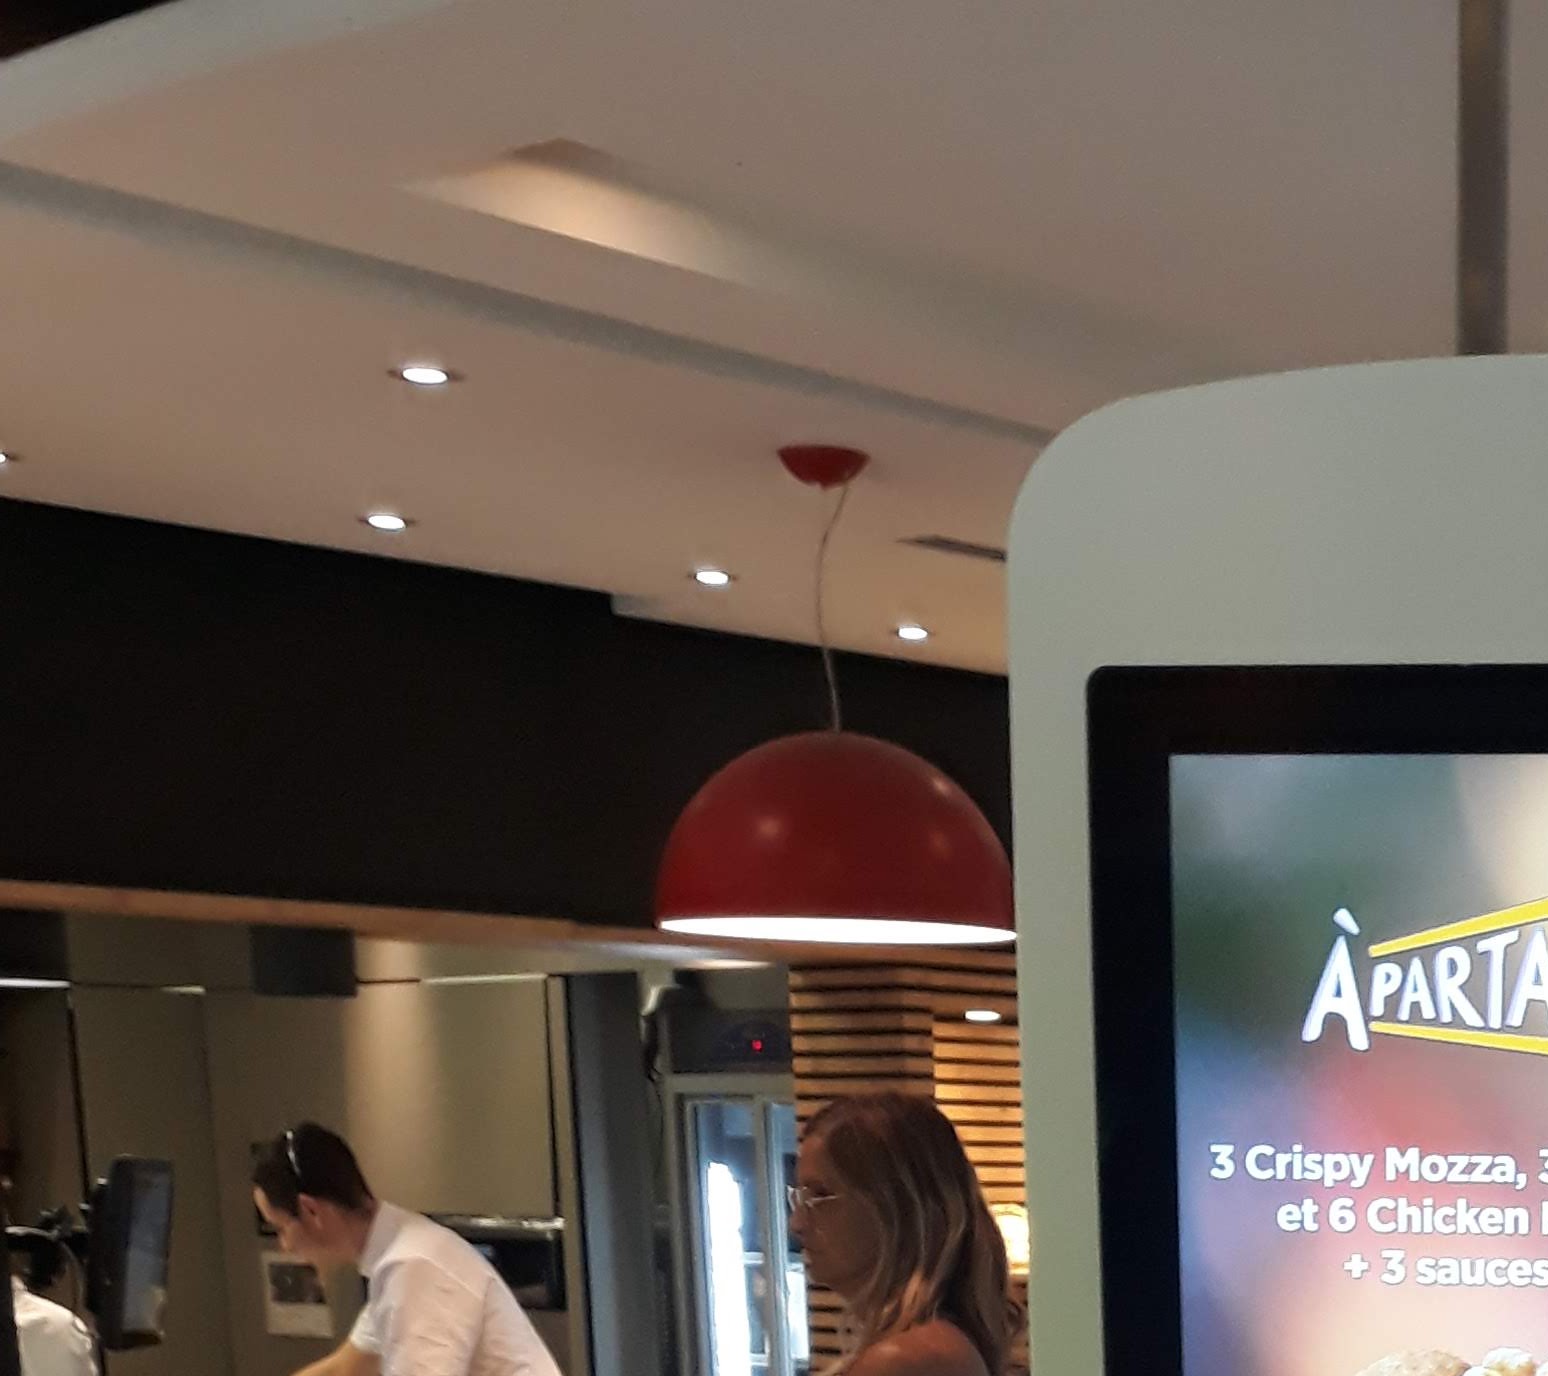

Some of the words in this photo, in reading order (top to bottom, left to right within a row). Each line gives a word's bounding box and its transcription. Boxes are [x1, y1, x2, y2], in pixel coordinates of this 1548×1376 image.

[1302, 907, 1370, 1051] À
[1209, 1144, 1235, 1179] 3
[1245, 1143, 1374, 1188] Crispy
[1385, 1147, 1527, 1190] Mozza,
[1277, 1198, 1319, 1232] et
[1328, 1198, 1357, 1232] 6
[1366, 1198, 1529, 1235] Chicken
[1380, 1249, 1406, 1286] 3
